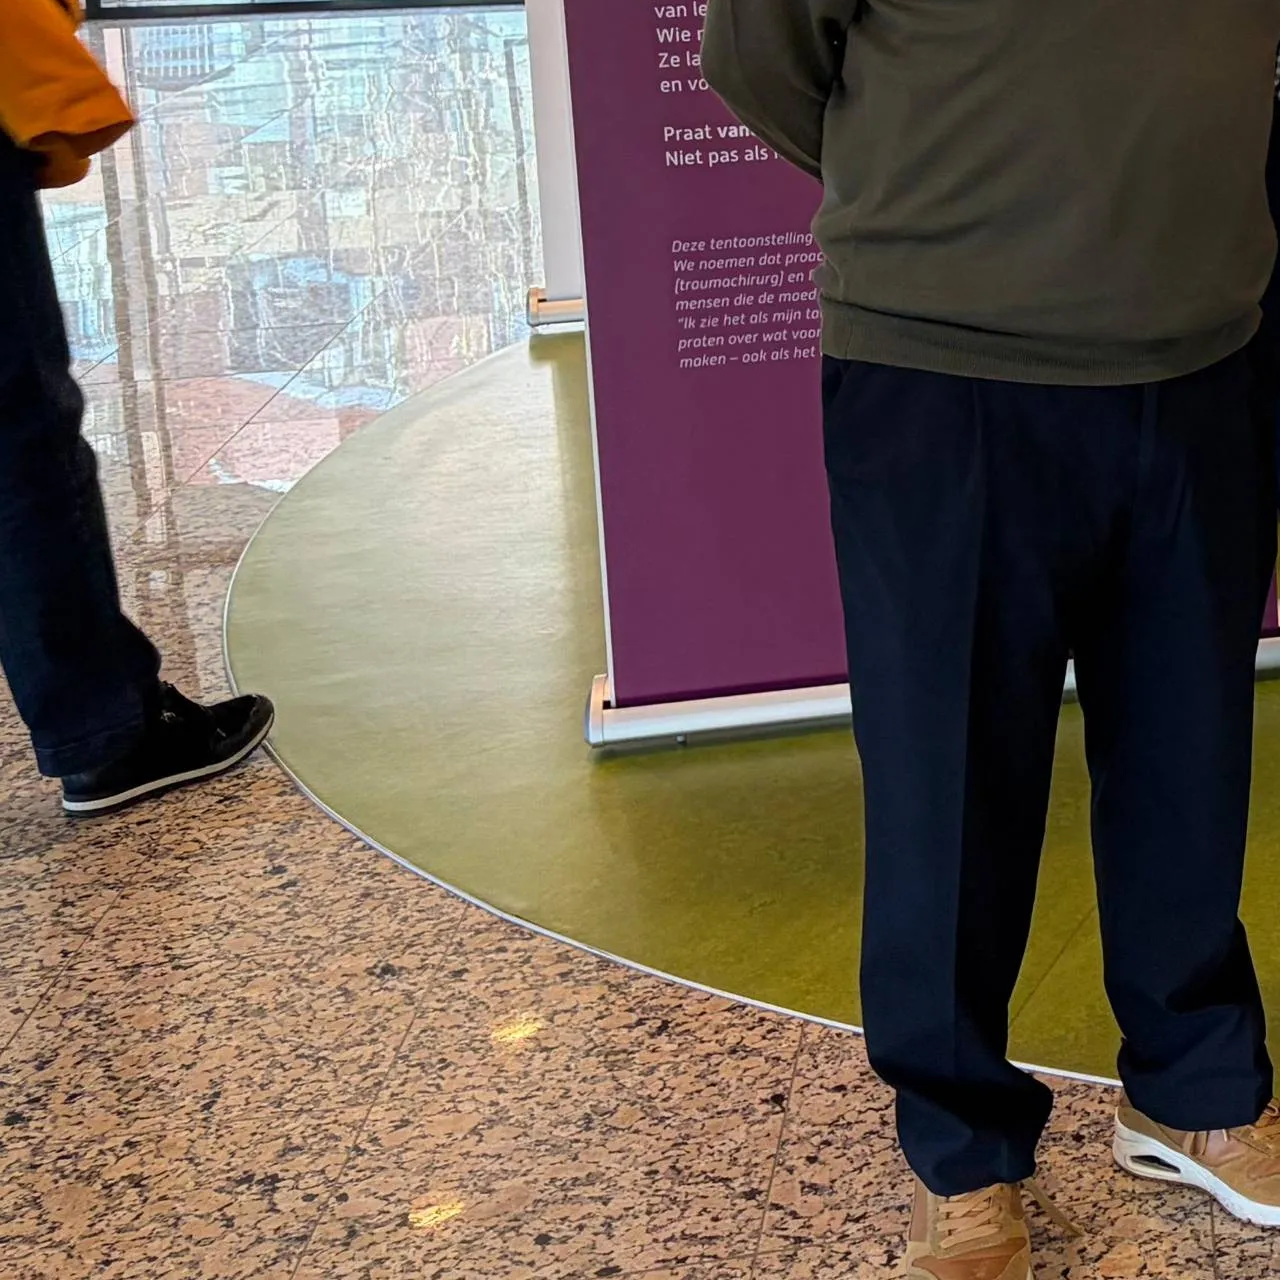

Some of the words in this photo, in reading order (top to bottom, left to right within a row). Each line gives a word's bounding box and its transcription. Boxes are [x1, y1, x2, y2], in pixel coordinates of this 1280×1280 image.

[655, 5, 686, 18] van
[656, 27, 690, 43] Wie
[659, 52, 680, 68] Ze
[660, 80, 682, 93] en
[664, 125, 712, 141] Praat
[717, 124, 755, 138] van
[666, 150, 703, 166] Niet
[709, 150, 738, 167] pas
[744, 145, 768, 161] als
[671, 239, 705, 253] Deze
[710, 232, 813, 250] tentoonstelling
[674, 259, 695, 271] We
[699, 257, 754, 269] noemen
[759, 253, 781, 266] dat
[788, 271, 804, 283] en
[676, 297, 729, 311] mensen
[734, 293, 754, 305] die
[758, 292, 774, 304] de
[779, 289, 817, 302] moed
[701, 315, 719, 328] zie
[724, 313, 745, 326] het
[750, 311, 769, 323] als
[773, 309, 801, 324] mijn
[678, 335, 724, 352] praten
[728, 333, 758, 345] over
[763, 329, 787, 341] wat
[792, 328, 821, 339] voor
[680, 354, 726, 368] maken
[742, 351, 766, 363] ook
[771, 348, 789, 361] als
[793, 346, 815, 358] het
